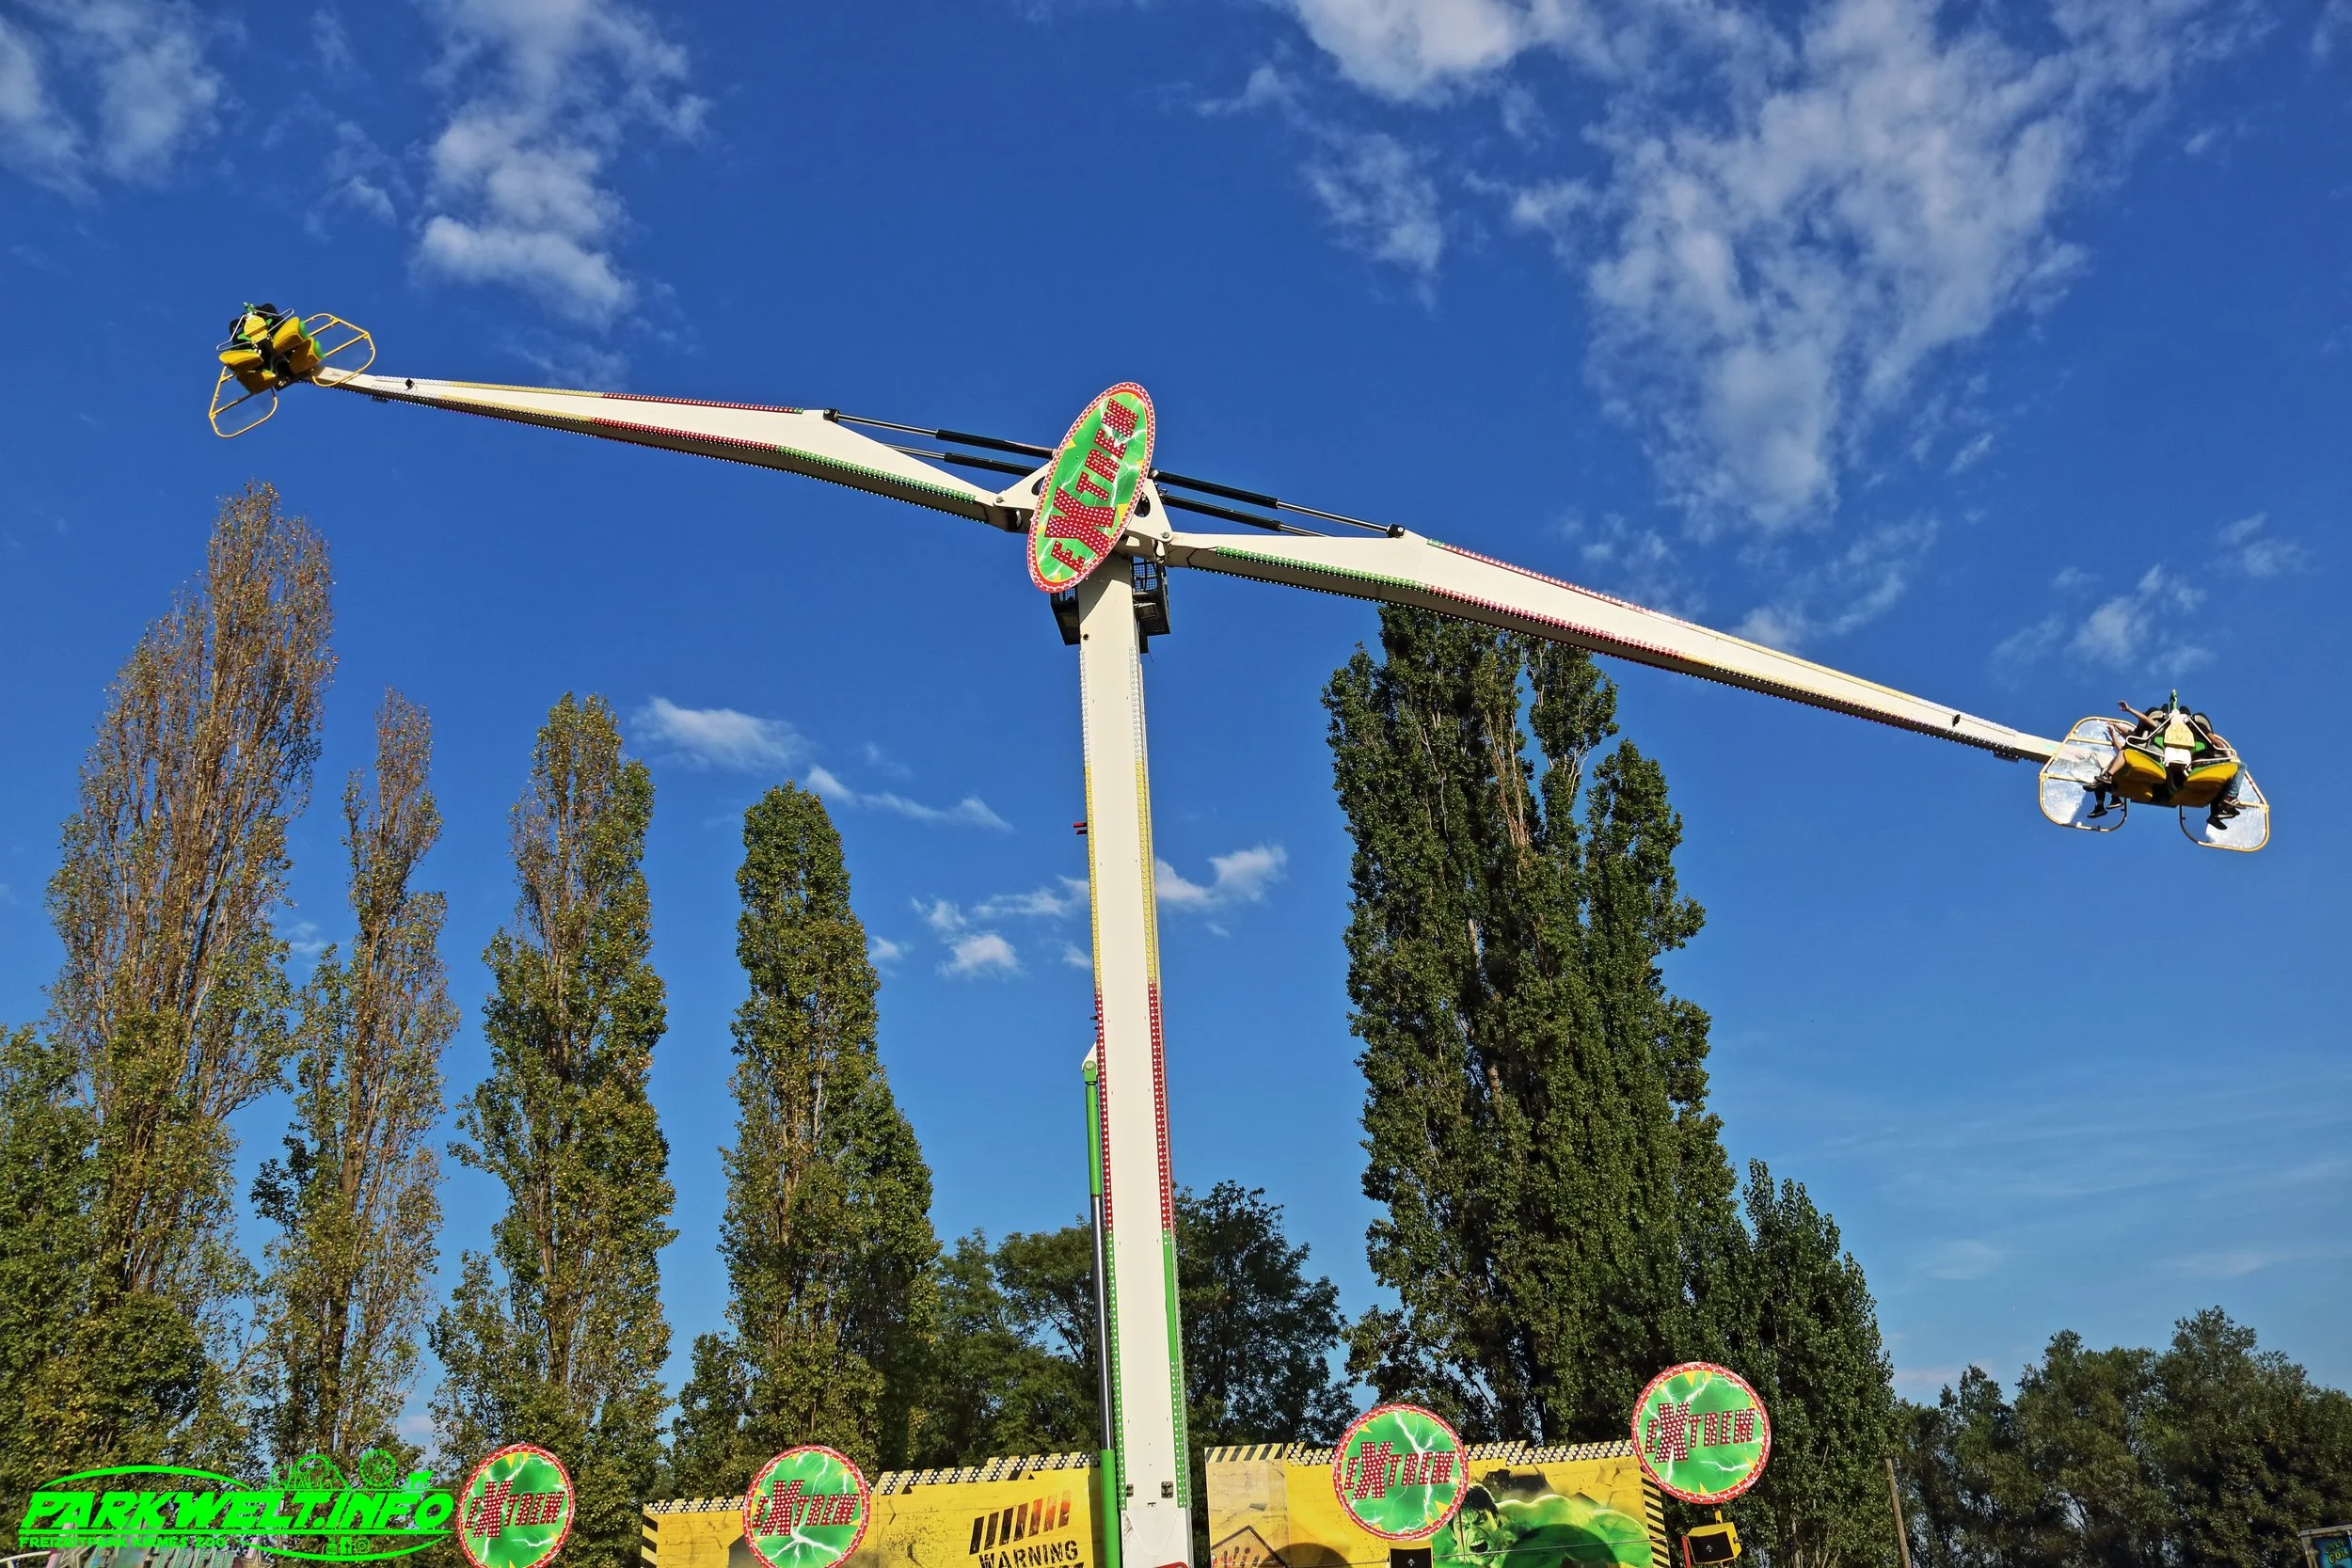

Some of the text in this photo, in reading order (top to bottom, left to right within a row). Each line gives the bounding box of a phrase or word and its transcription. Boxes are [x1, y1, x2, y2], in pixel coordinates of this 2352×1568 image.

[1044, 398, 1139, 573] EXTREM
[1645, 1402, 1756, 1463] EXTREM
[1344, 1441, 1456, 1499] EXTREM
[464, 1481, 565, 1538] EXTREM
[753, 1480, 860, 1536] EXTREM
[978, 1540, 1079, 1568] WARNING
